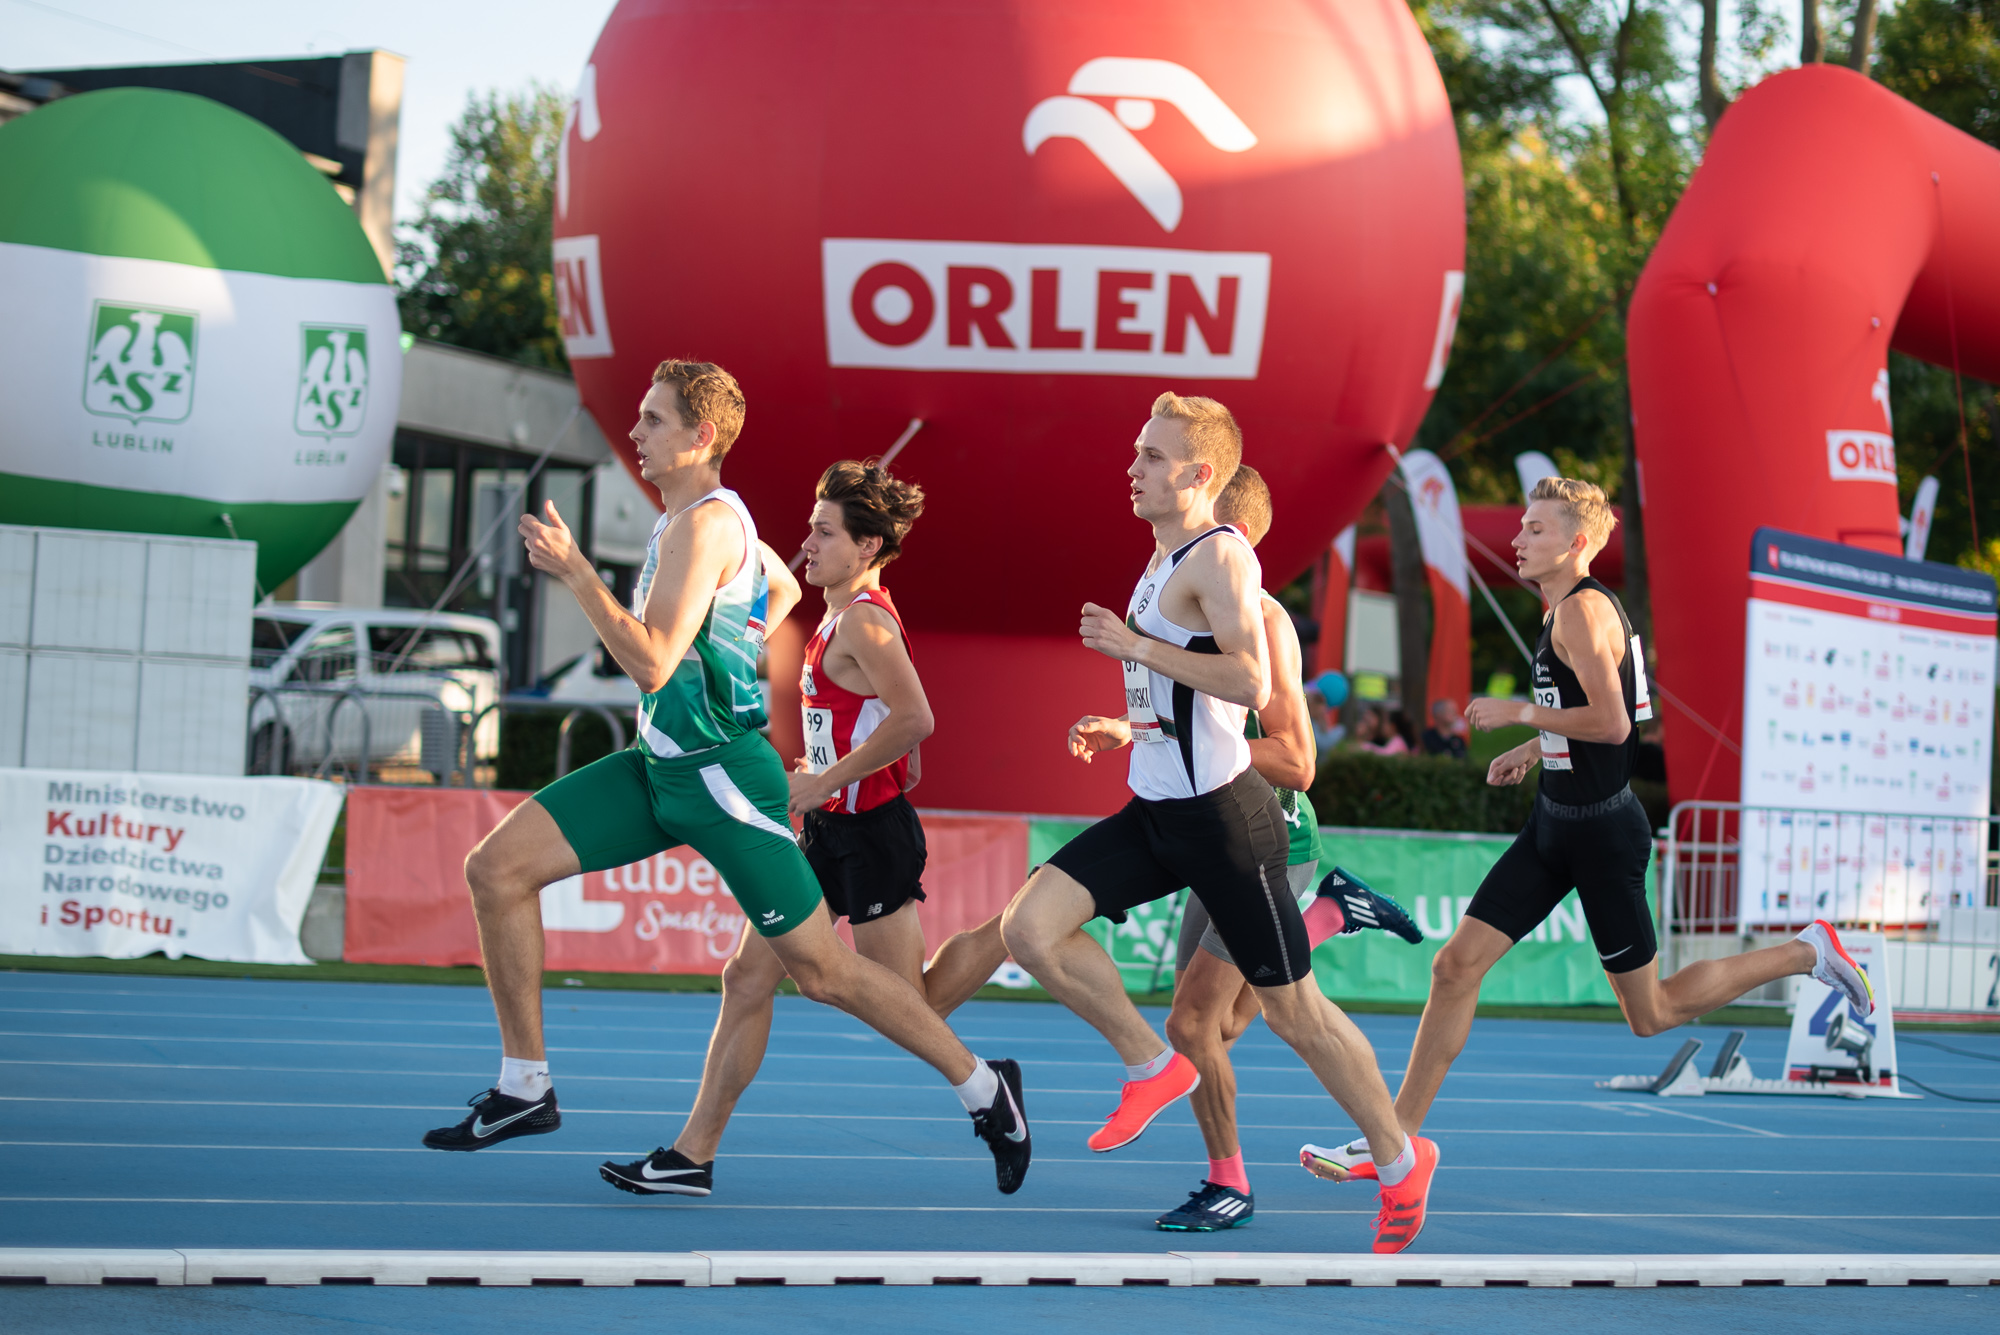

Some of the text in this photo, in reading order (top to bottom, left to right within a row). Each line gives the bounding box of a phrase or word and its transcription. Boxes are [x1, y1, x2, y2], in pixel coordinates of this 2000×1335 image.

[852, 261, 1241, 356] ORLEN
[93, 430, 173, 453] LUBLIN
[296, 449, 347, 466] LUBLIN
[807, 712, 823, 732] 99
[48, 781, 246, 821] Ministerstwo
[1552, 802, 1577, 819] PRO
[1581, 793, 1620, 819] NIKE
[46, 810, 184, 851] Kultury
[44, 844, 224, 881] Dziedzictwa
[42, 872, 230, 911] Narodowego
[41, 906, 48, 925] i
[763, 914, 784, 926] erima
